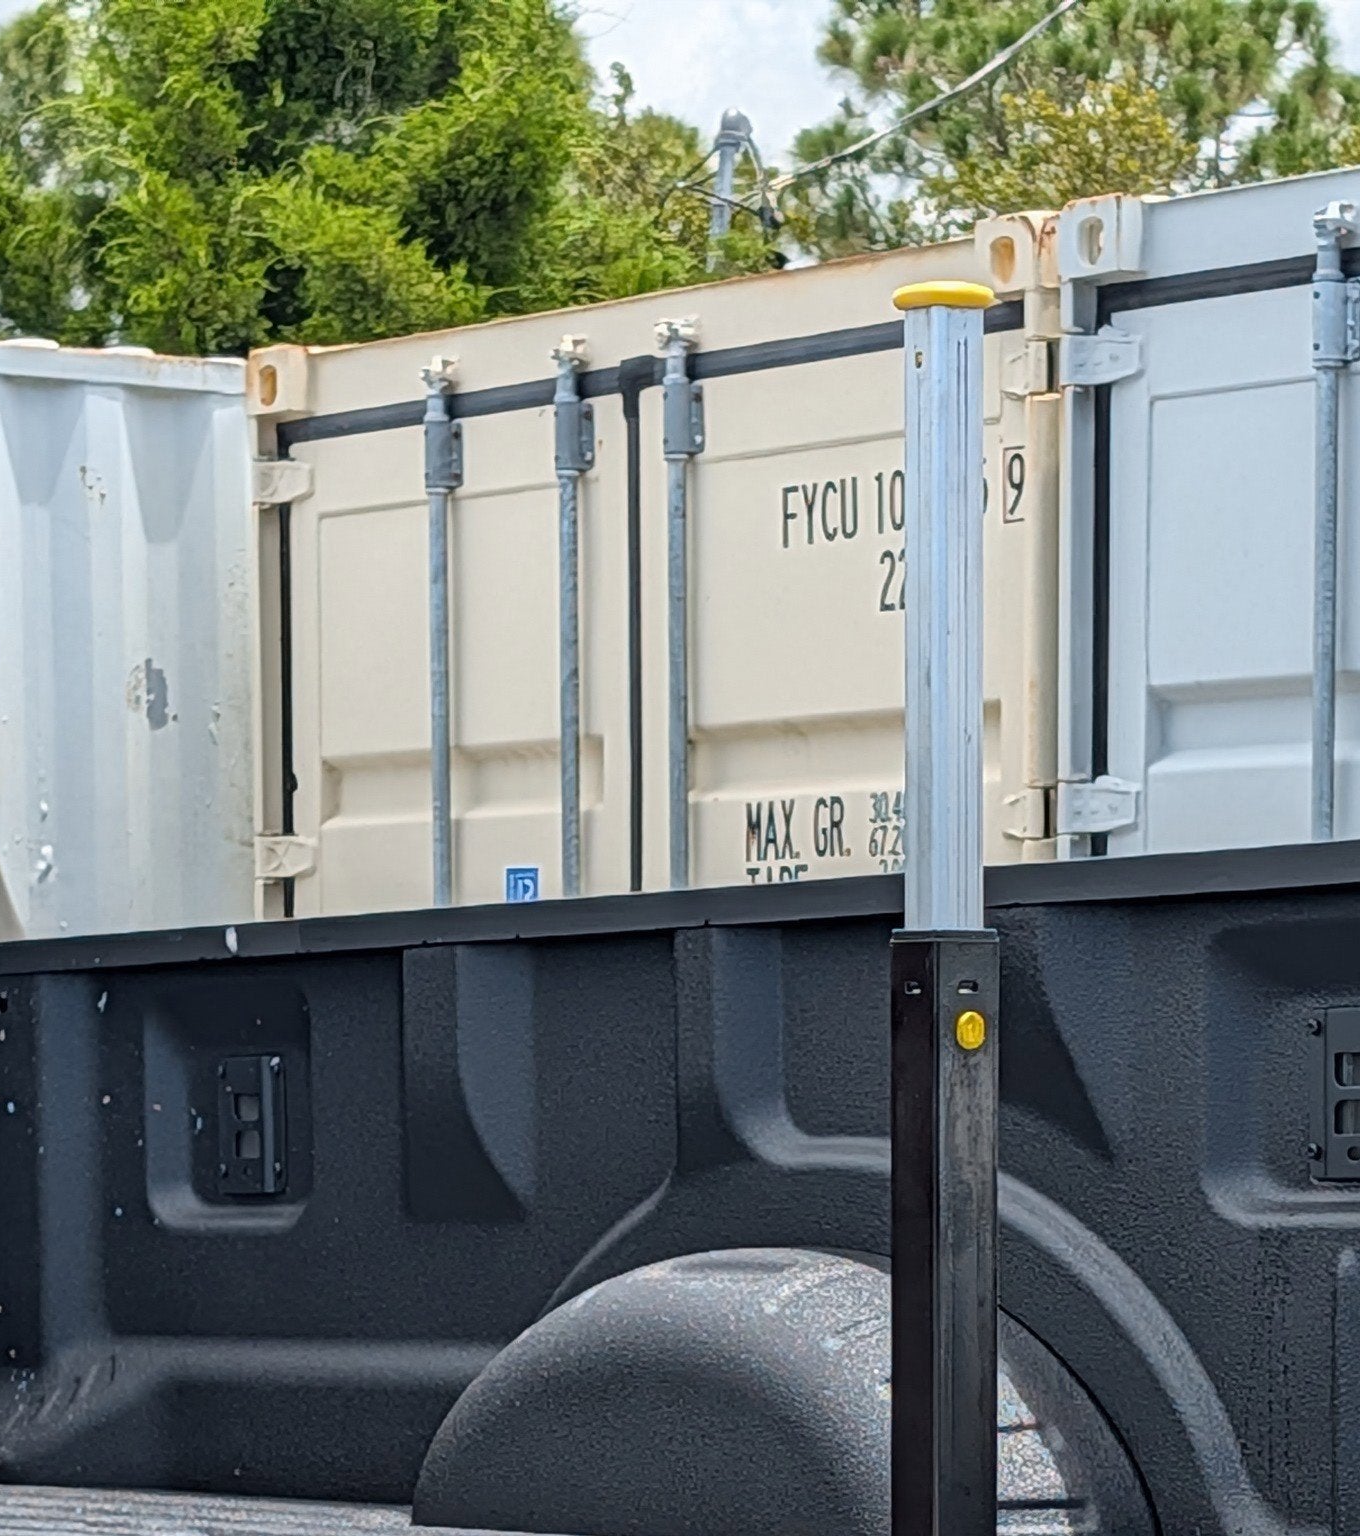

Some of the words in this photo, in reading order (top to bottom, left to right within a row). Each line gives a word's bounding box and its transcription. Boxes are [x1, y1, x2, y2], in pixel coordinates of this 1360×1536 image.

[782, 476, 858, 548] FYCU
[1007, 453, 1025, 515] 9
[813, 796, 852, 858] GR.
